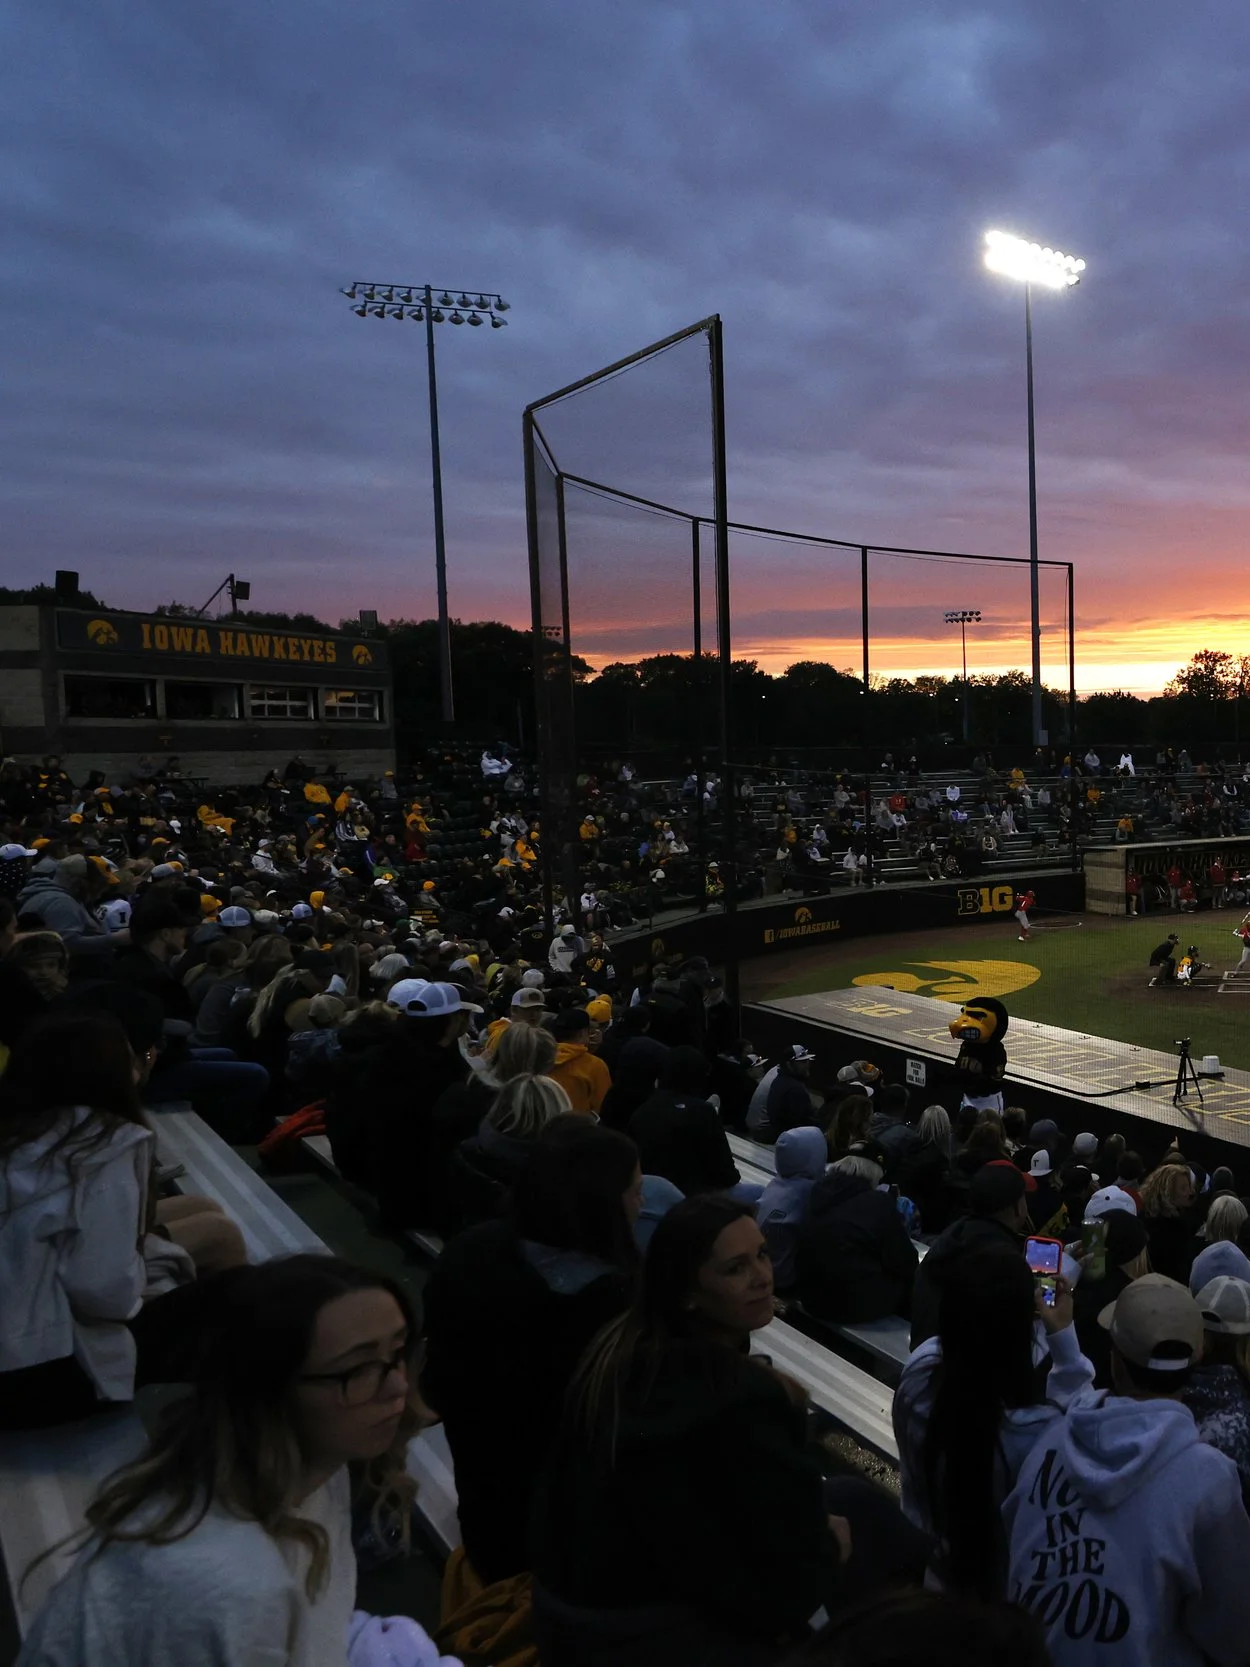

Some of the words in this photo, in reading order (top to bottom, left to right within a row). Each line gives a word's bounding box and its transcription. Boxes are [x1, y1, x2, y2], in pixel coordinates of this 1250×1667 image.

[141, 623, 211, 654] IOWA
[219, 630, 337, 664] HAWKEYES
[1029, 1449, 1081, 1509] NO
[1045, 1506, 1088, 1547] IN
[1031, 1537, 1106, 1581] THE
